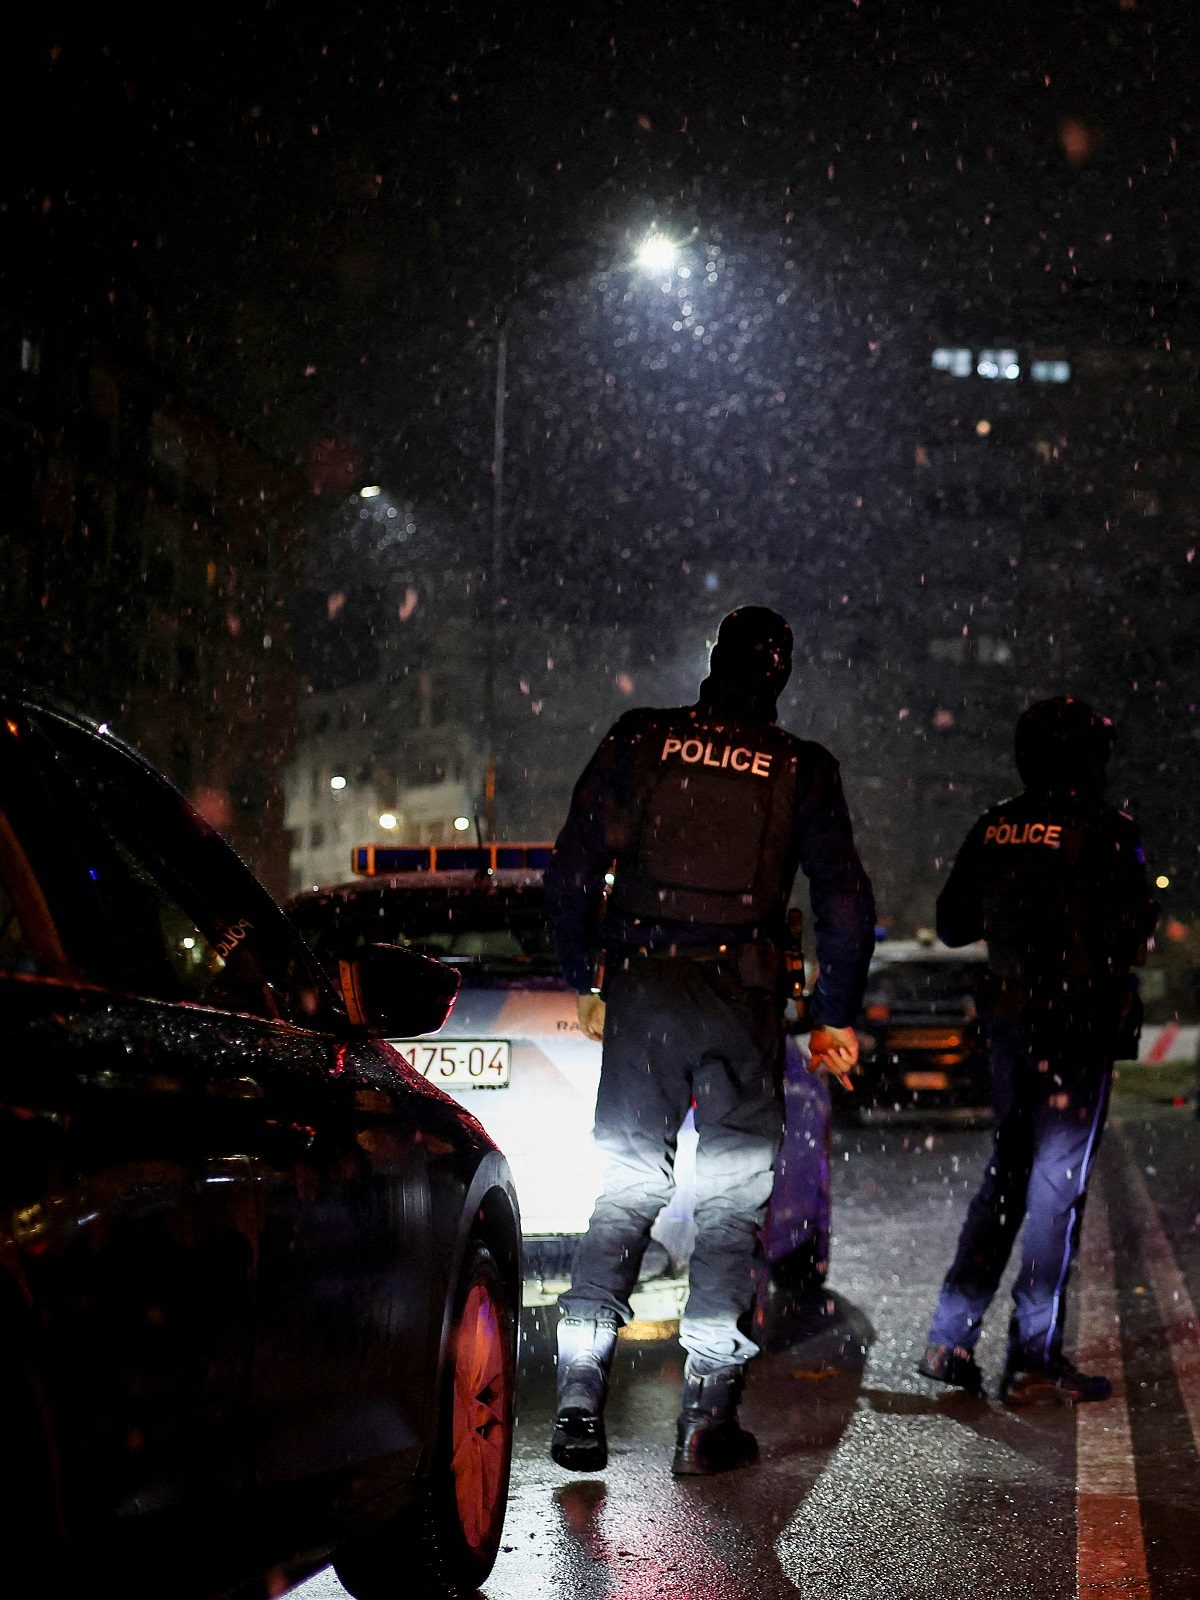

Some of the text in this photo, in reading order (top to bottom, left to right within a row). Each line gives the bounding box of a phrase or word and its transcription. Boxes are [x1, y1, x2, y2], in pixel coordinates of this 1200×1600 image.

[661, 738, 773, 778] POLICE
[983, 823, 1062, 849] POLICE
[406, 1047, 503, 1077] 175-04
